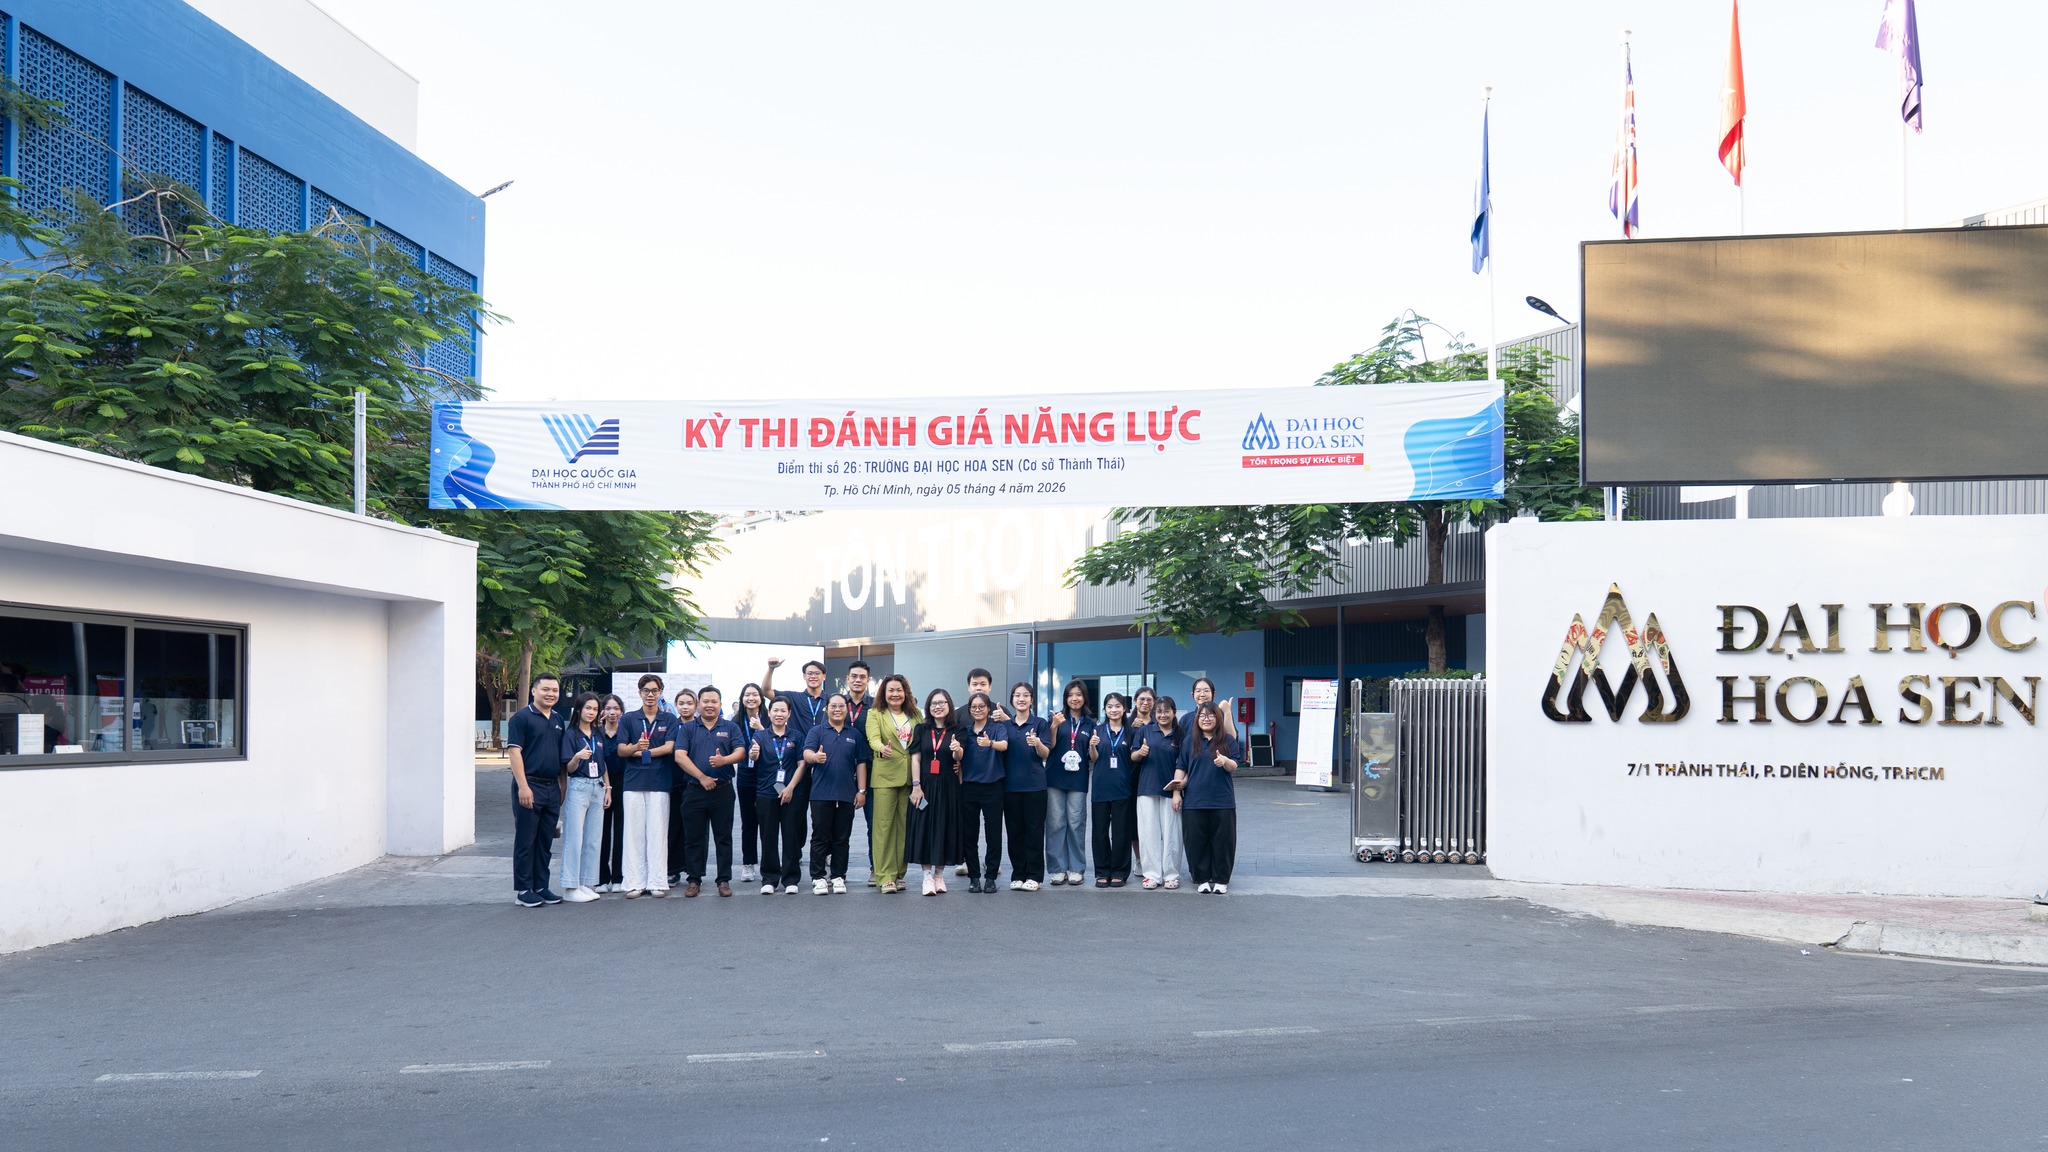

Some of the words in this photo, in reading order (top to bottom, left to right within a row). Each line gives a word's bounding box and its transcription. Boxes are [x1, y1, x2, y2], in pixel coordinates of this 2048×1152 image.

[685, 411, 731, 449] KỲ
[738, 418, 799, 449] THI
[808, 410, 918, 448] ĐÁNH
[927, 408, 993, 447] GIÁ
[1004, 406, 1115, 445] NĂNG
[1126, 405, 1201, 453] LỰC
[1286, 418, 1318, 433] ĐẠI
[1323, 416, 1364, 432] HỌC
[1286, 435, 1327, 450] HOA
[1330, 434, 1365, 448] SEN
[777, 460, 804, 474] Điểm
[808, 461, 823, 474] thi
[826, 460, 839, 474] số
[843, 461, 862, 474] 26:
[864, 459, 909, 473] TRƯỜNG
[913, 460, 932, 475] ĐẠI
[937, 460, 960, 475] HỌC
[964, 459, 987, 472] HOA
[991, 459, 1014, 472] SEN
[1018, 458, 1037, 473] (Cơ
[1041, 457, 1055, 471] sở
[1059, 457, 1092, 470] Thành
[1097, 457, 1126, 471] Thái)
[1250, 457, 1267, 466] TÔN
[1269, 457, 1298, 466] TRỌNG
[1300, 456, 1312, 466] SỰ
[1313, 455, 1336, 464] KHÁC
[1337, 454, 1356, 464] BIỆT
[531, 469, 550, 480] ĐẠI
[553, 469, 578, 480] HỌC
[580, 467, 614, 478] QUỐC
[617, 469, 637, 478] GIA
[531, 480, 560, 488] THÀNH
[597, 480, 612, 489] CHÍ
[823, 484, 839, 497] Tp.
[843, 484, 859, 495] Hồ
[862, 484, 881, 495] Chí
[882, 484, 913, 496] Minh,
[916, 484, 944, 497] ngày
[946, 483, 961, 494] 05
[963, 483, 996, 496] tháng
[998, 483, 1006, 494] 4
[1009, 482, 1034, 493] năm
[1037, 482, 1066, 493] 2026
[816, 526, 906, 614] TÔN
[1715, 602, 1846, 660] ĐẠI
[1868, 600, 2038, 659] HỌC
[1715, 674, 1882, 725] HOA
[1897, 673, 2042, 726] SEN
[1627, 763, 1650, 777] 7/1
[1655, 761, 1713, 777] THÀNH
[1716, 763, 1759, 779] THÁI,
[1764, 766, 1776, 778] P.
[1780, 763, 1819, 779] DIÊN
[1823, 762, 1879, 781] HỒNG,
